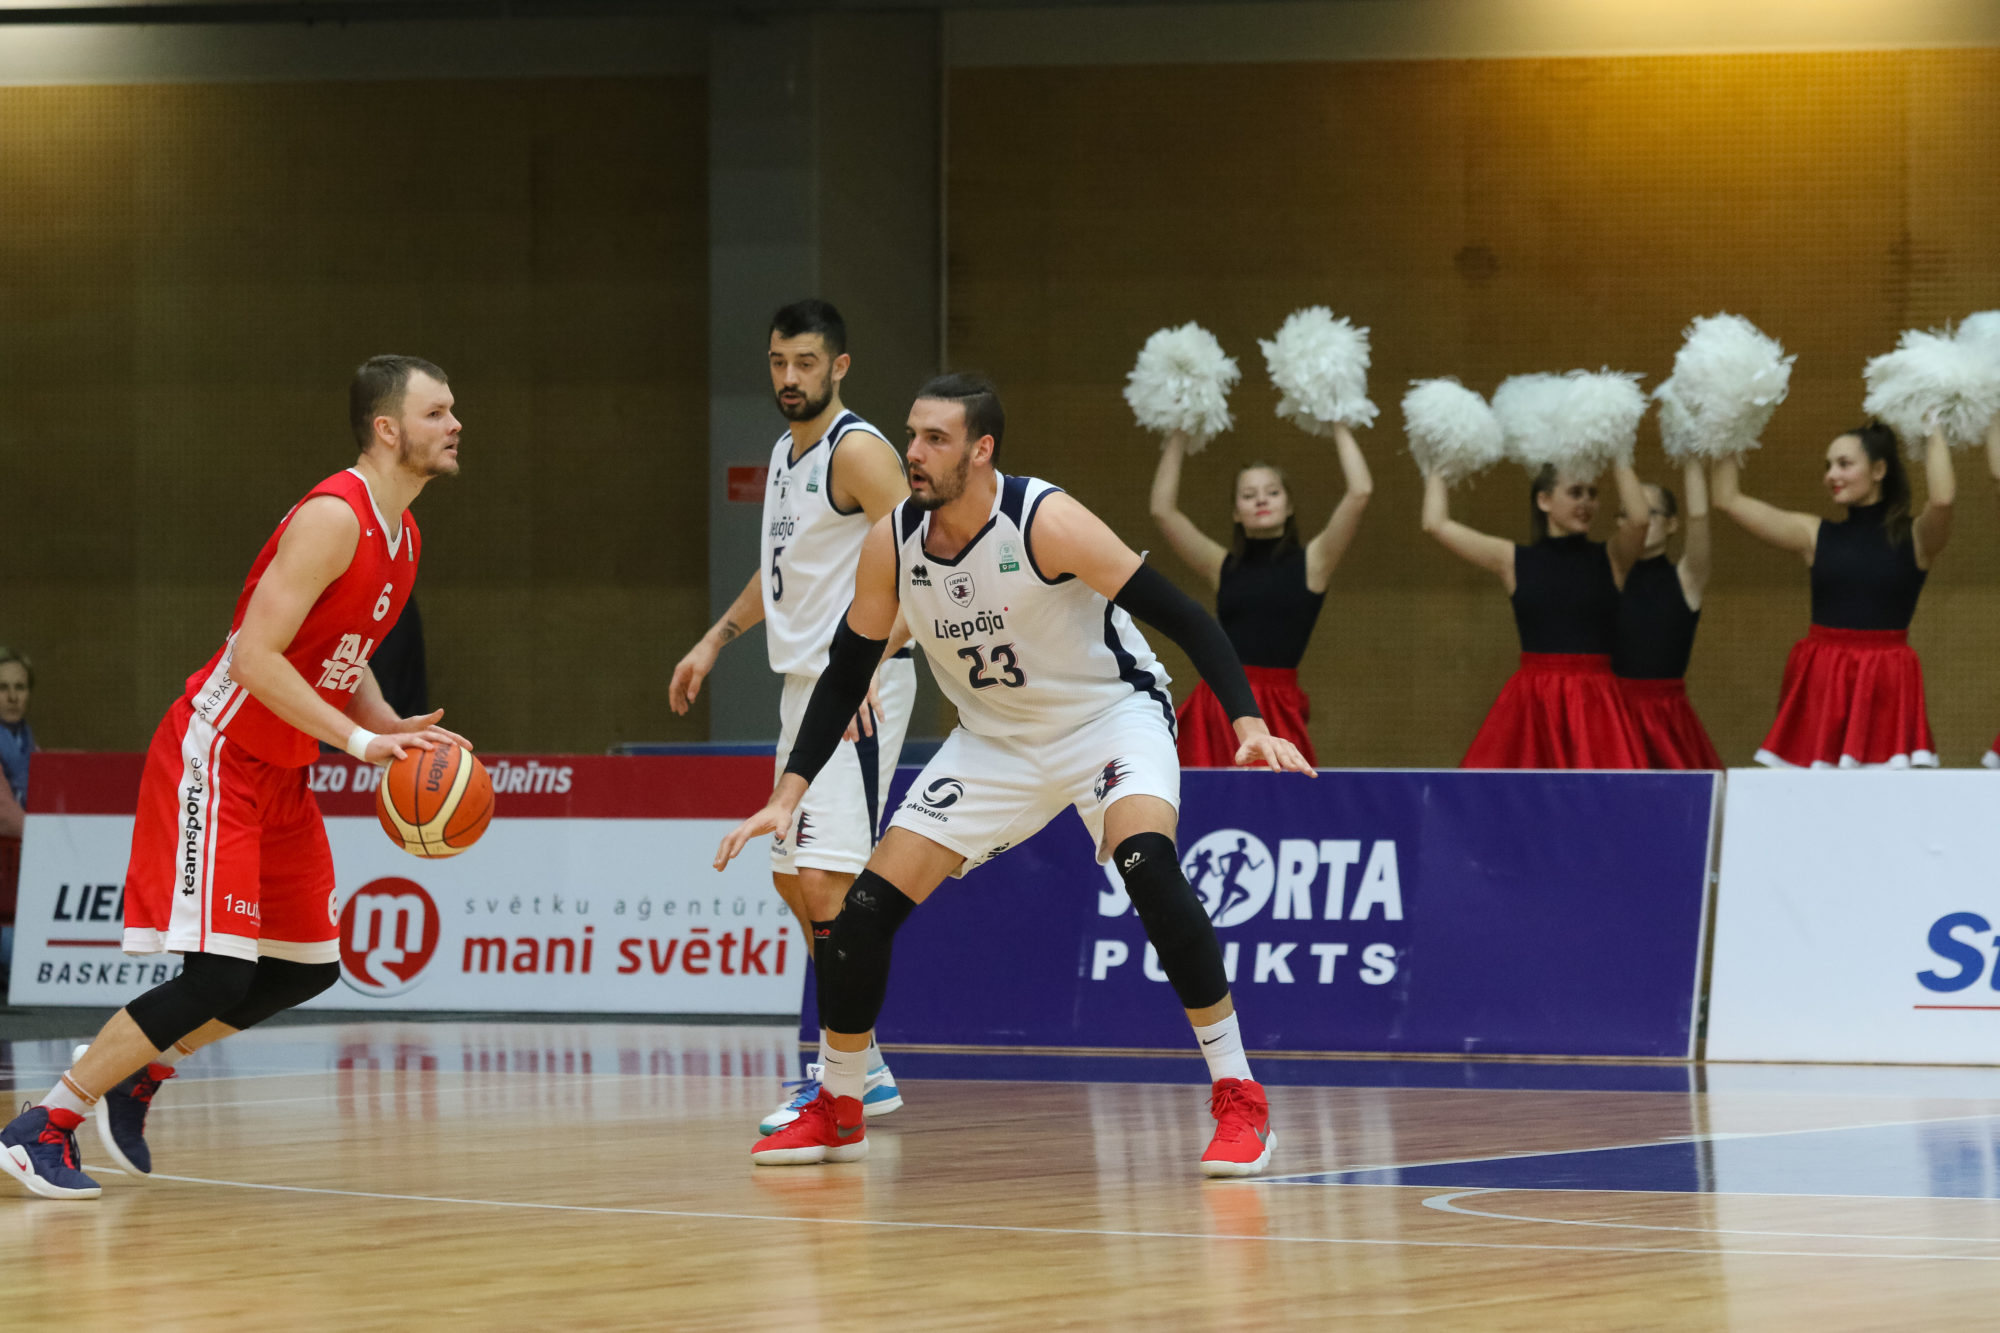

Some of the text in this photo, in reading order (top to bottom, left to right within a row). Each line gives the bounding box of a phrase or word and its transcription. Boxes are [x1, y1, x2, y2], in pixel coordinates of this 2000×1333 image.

[771, 546, 786, 602] 5
[372, 582, 393, 622] 6
[934, 610, 1005, 641] Liepāja
[957, 641, 1028, 692] 23
[199, 670, 233, 721] SKEPAS
[182, 757, 204, 896] teamsport.ee
[906, 802, 949, 823] ekovalis
[465, 896, 790, 921] svētku aģentūra
[462, 926, 789, 976] mani svētki
